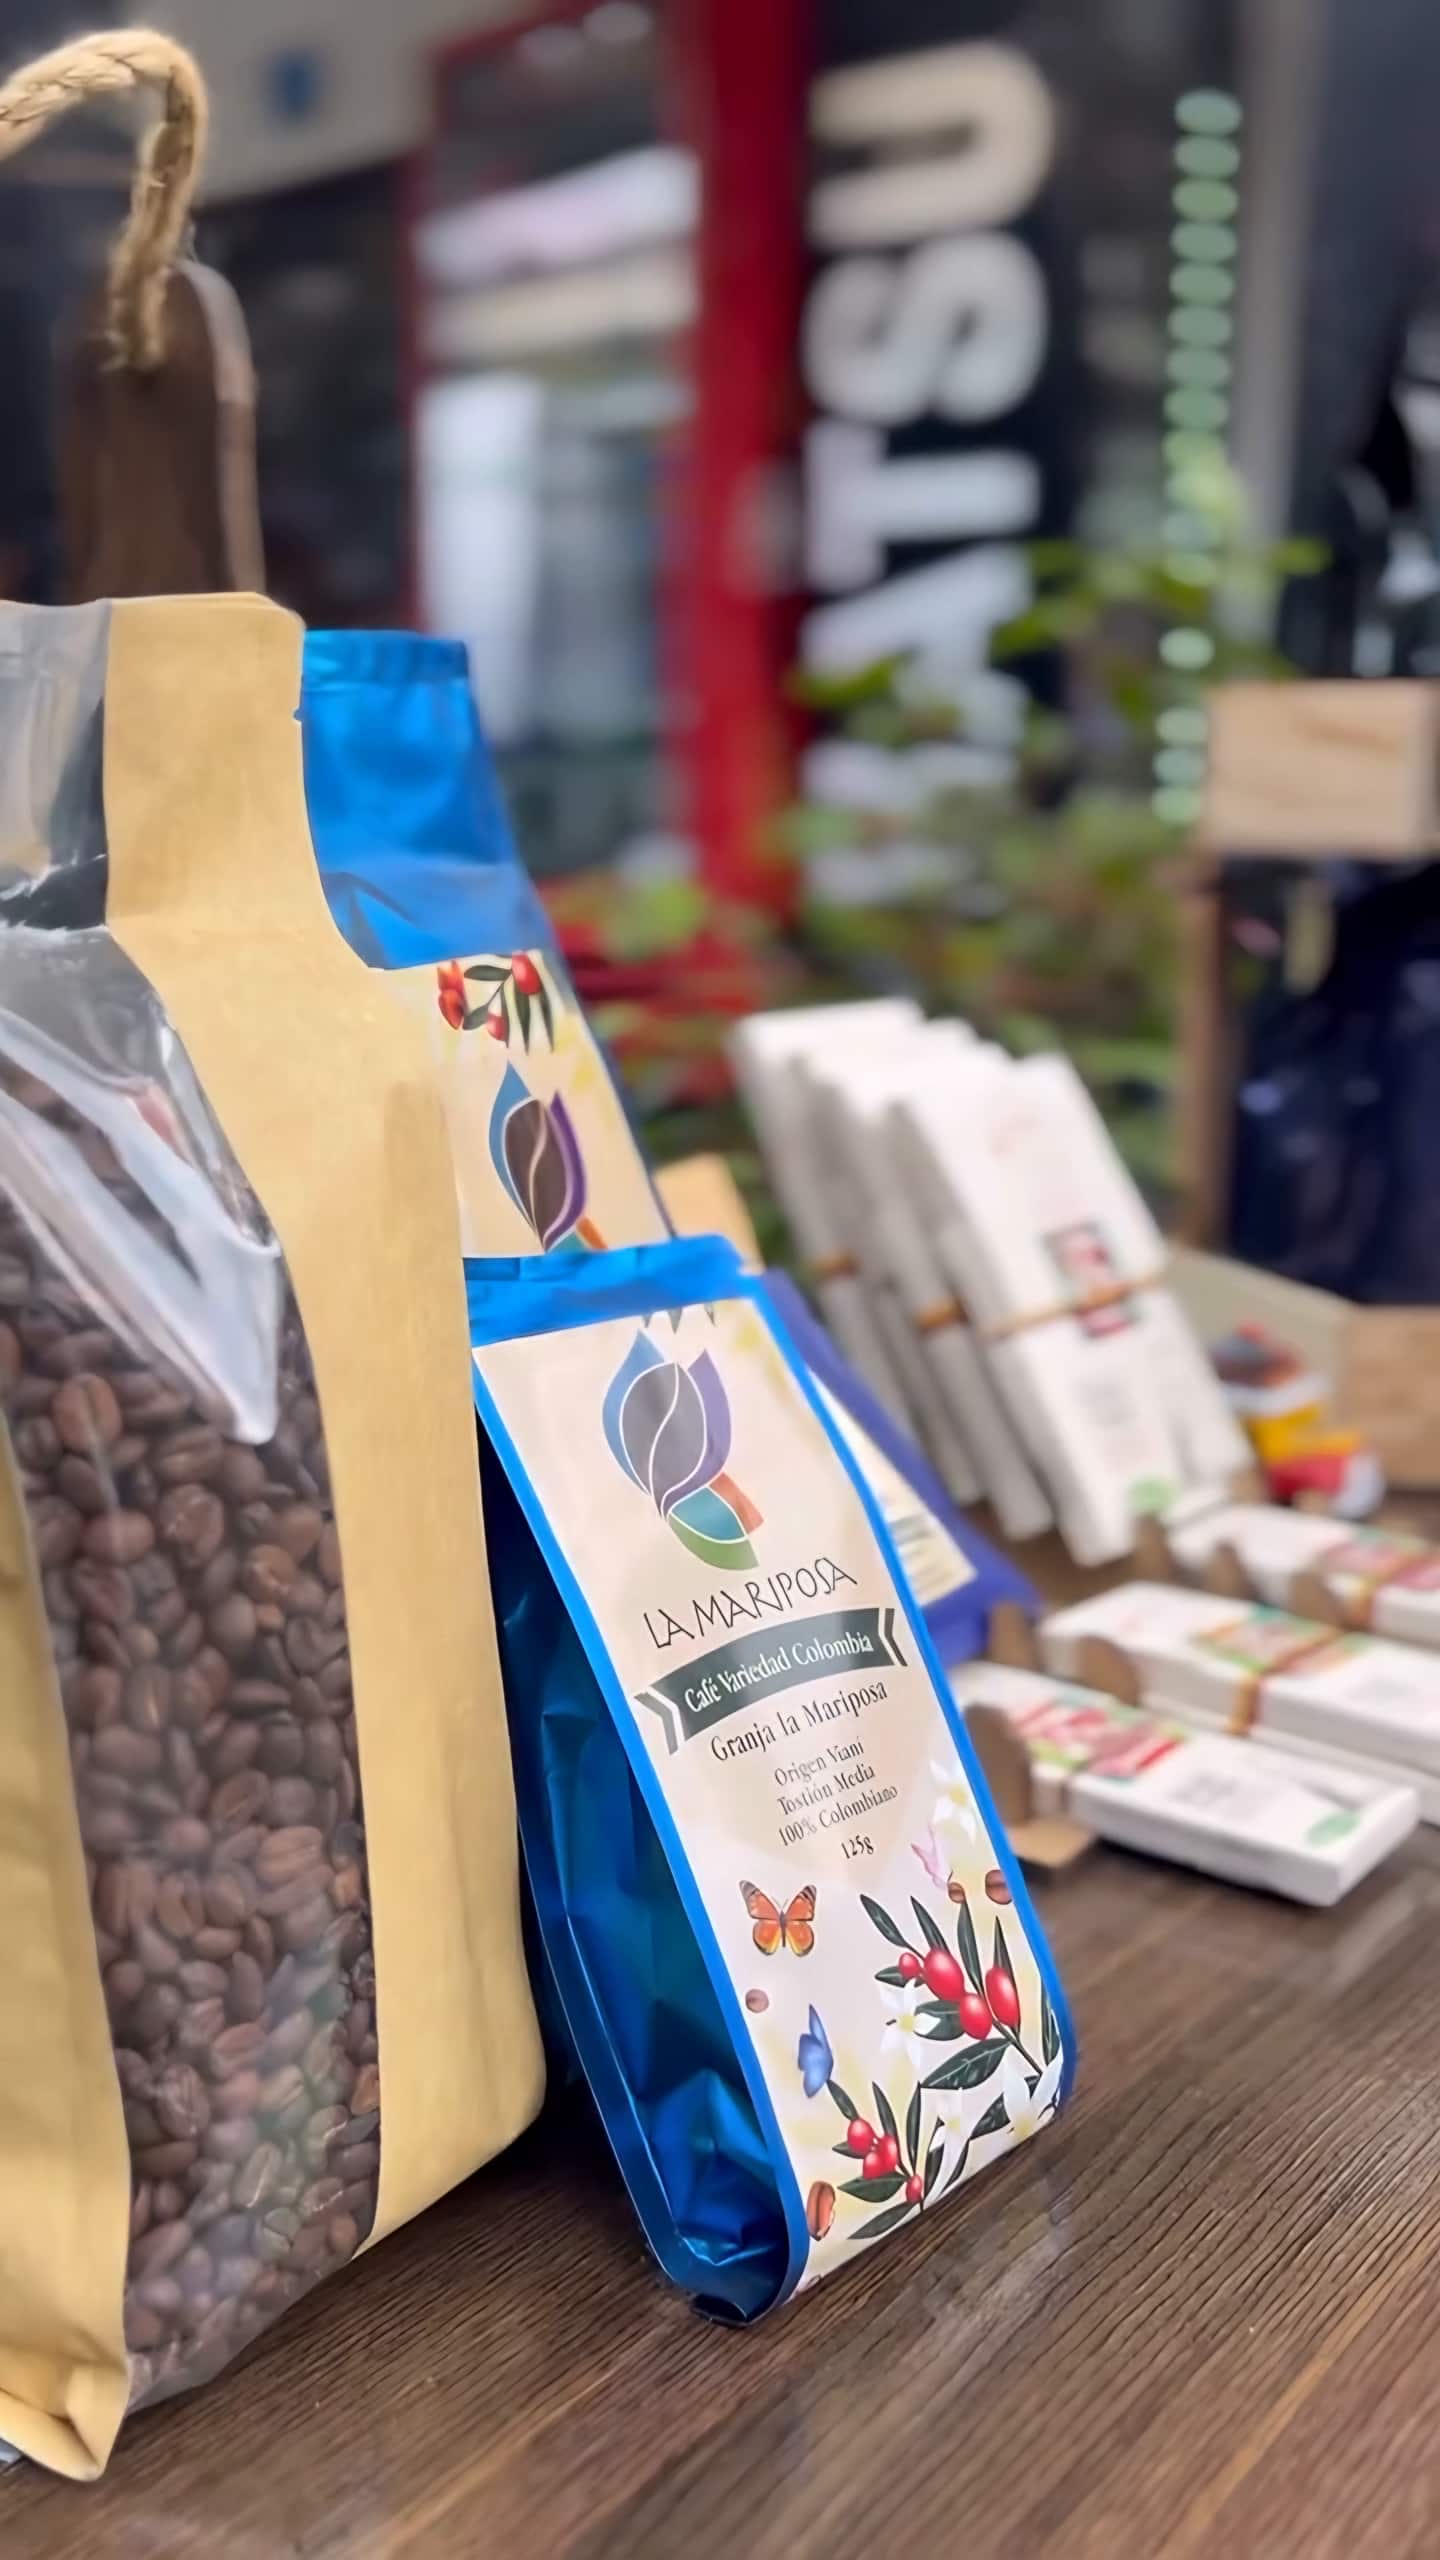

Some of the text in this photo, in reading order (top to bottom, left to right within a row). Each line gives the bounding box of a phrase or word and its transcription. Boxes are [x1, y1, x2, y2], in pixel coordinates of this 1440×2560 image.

[643, 1608, 695, 1649] LA
[692, 1557, 858, 1637] MARIPOSA
[684, 1631, 874, 1712] Café Variedad Colombia
[711, 1681, 888, 1761] Granja la Mariposa
[774, 1756, 827, 1786] Origen
[777, 1782, 833, 1815] Tostión
[778, 1785, 898, 1847] 100% Colombiano
[841, 1835, 874, 1859] 125g
